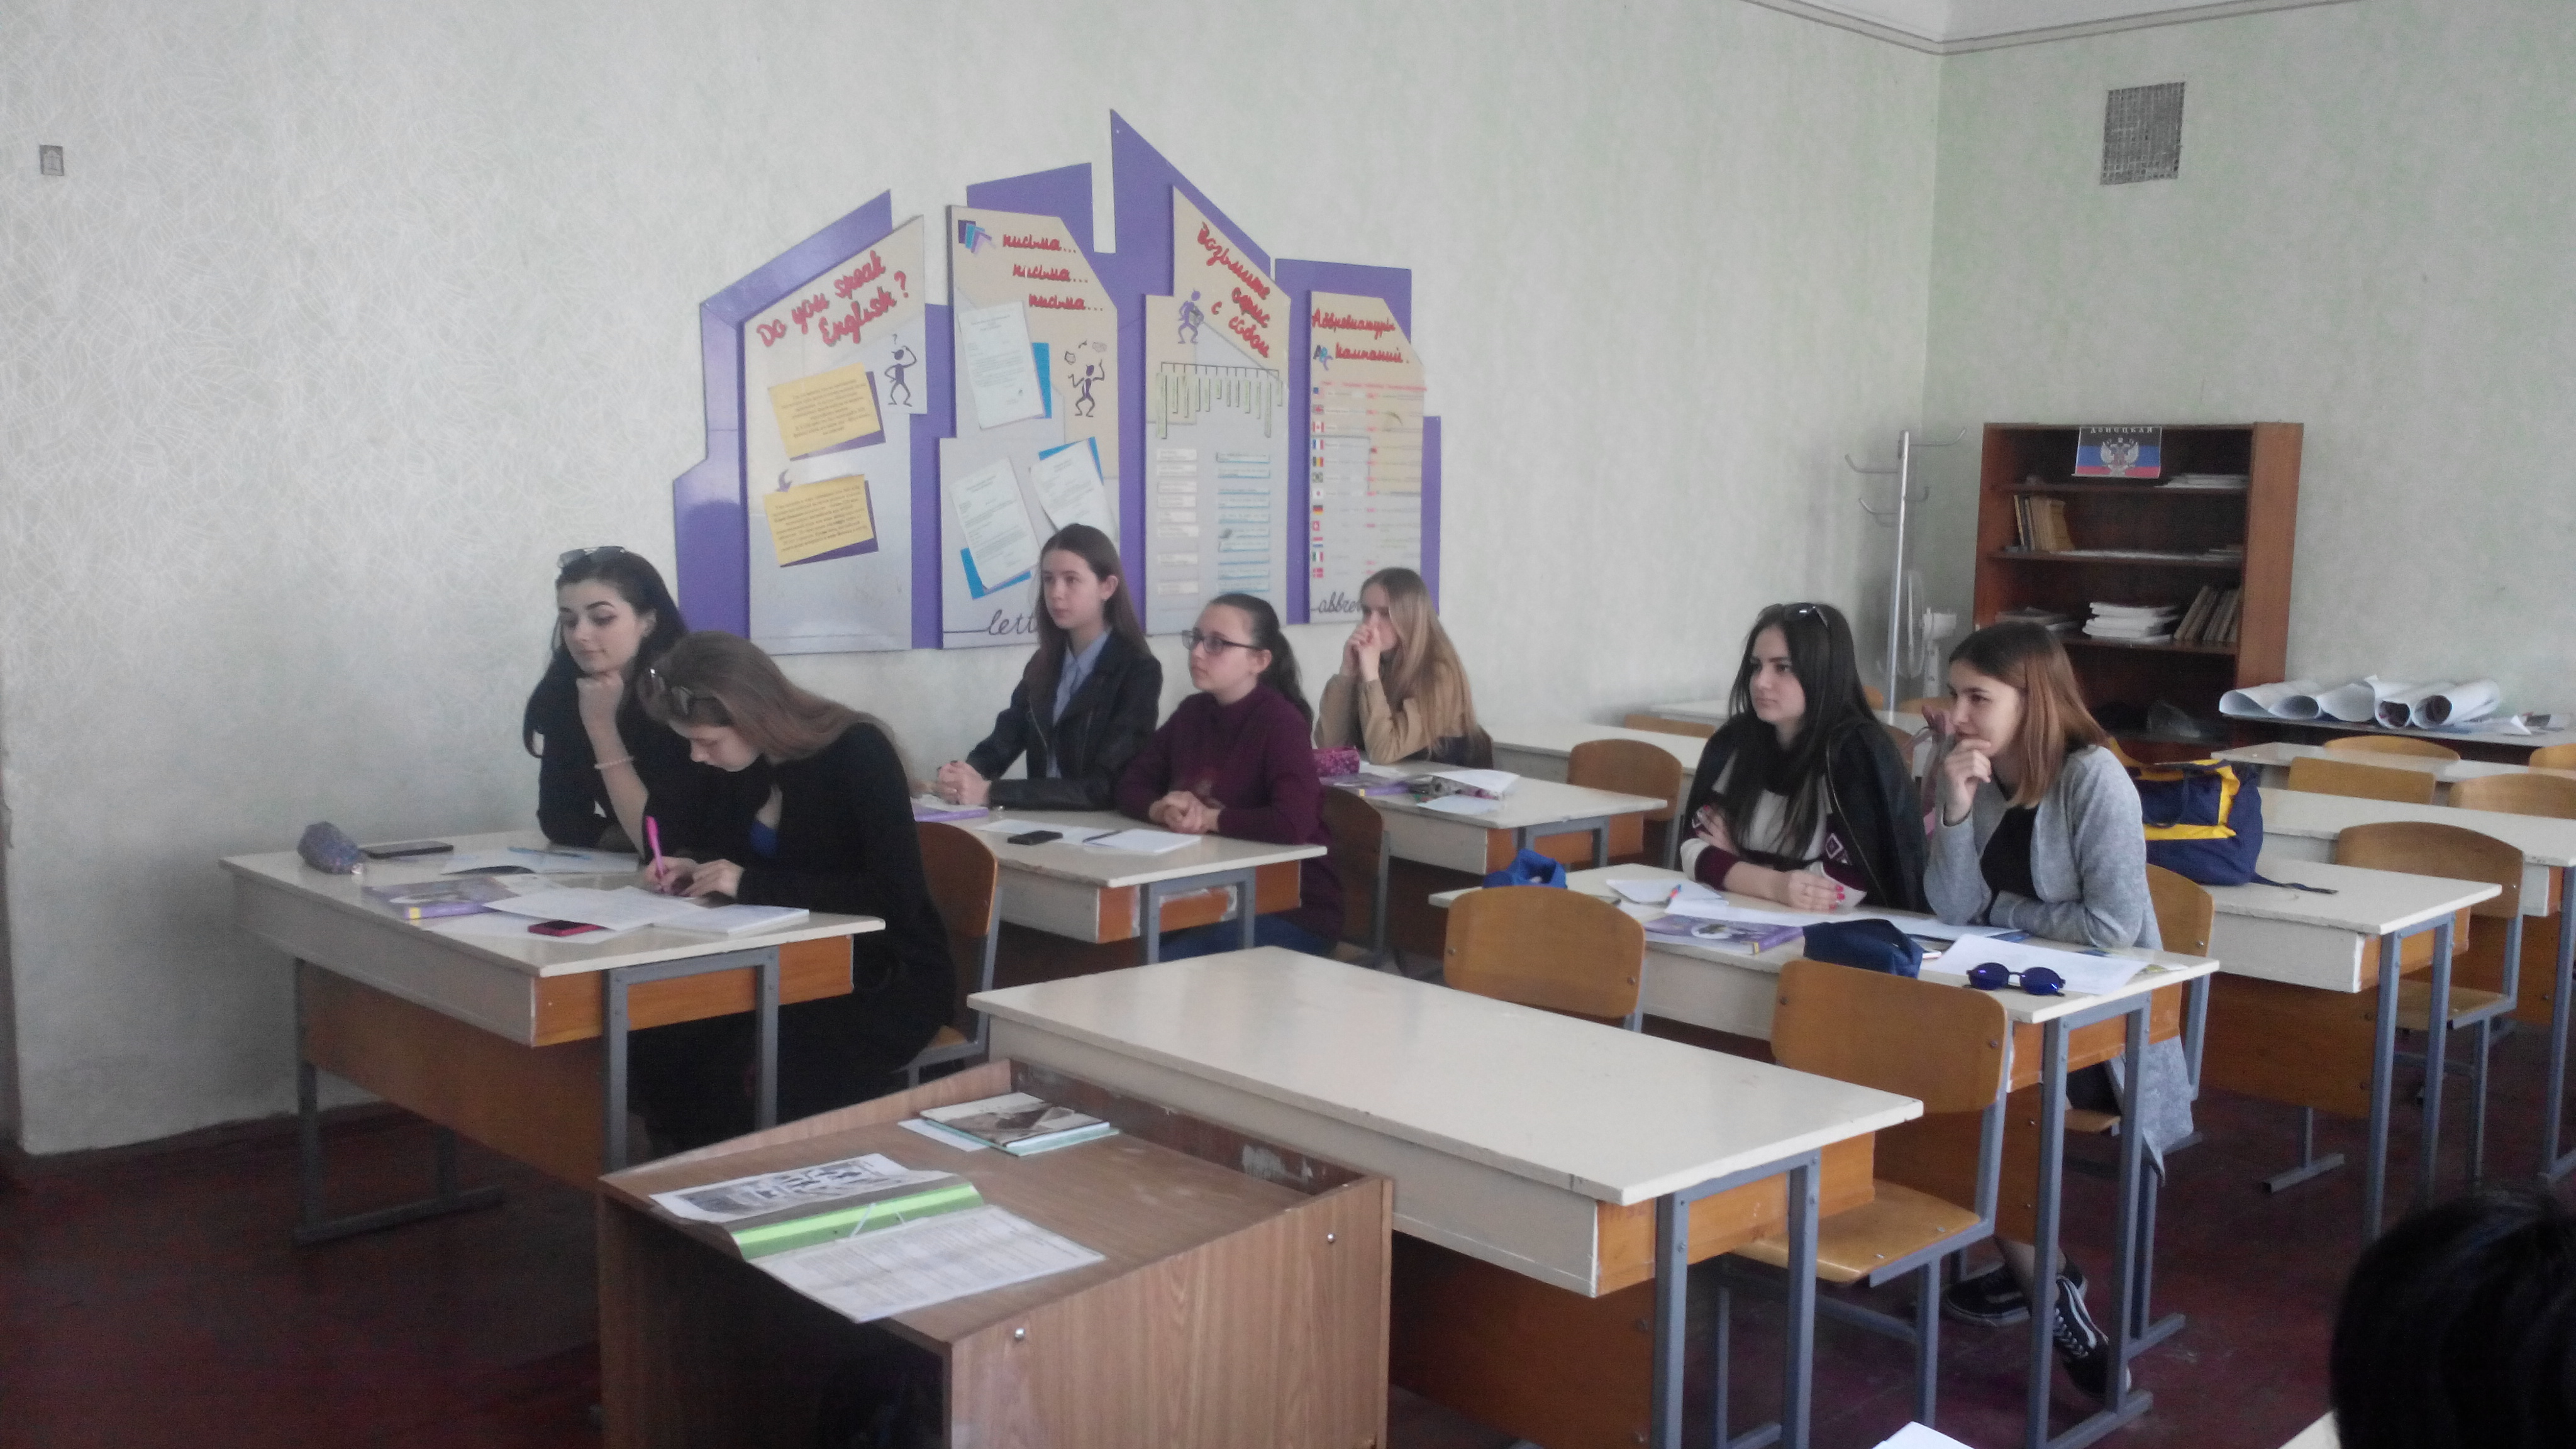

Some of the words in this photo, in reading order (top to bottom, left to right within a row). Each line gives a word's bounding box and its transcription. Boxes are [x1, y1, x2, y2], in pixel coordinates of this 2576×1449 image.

[756, 318, 787, 347] Do
[791, 293, 830, 335] you
[834, 250, 886, 299] speak
[1228, 316, 1270, 358] собой
[988, 609, 1039, 636] lett
